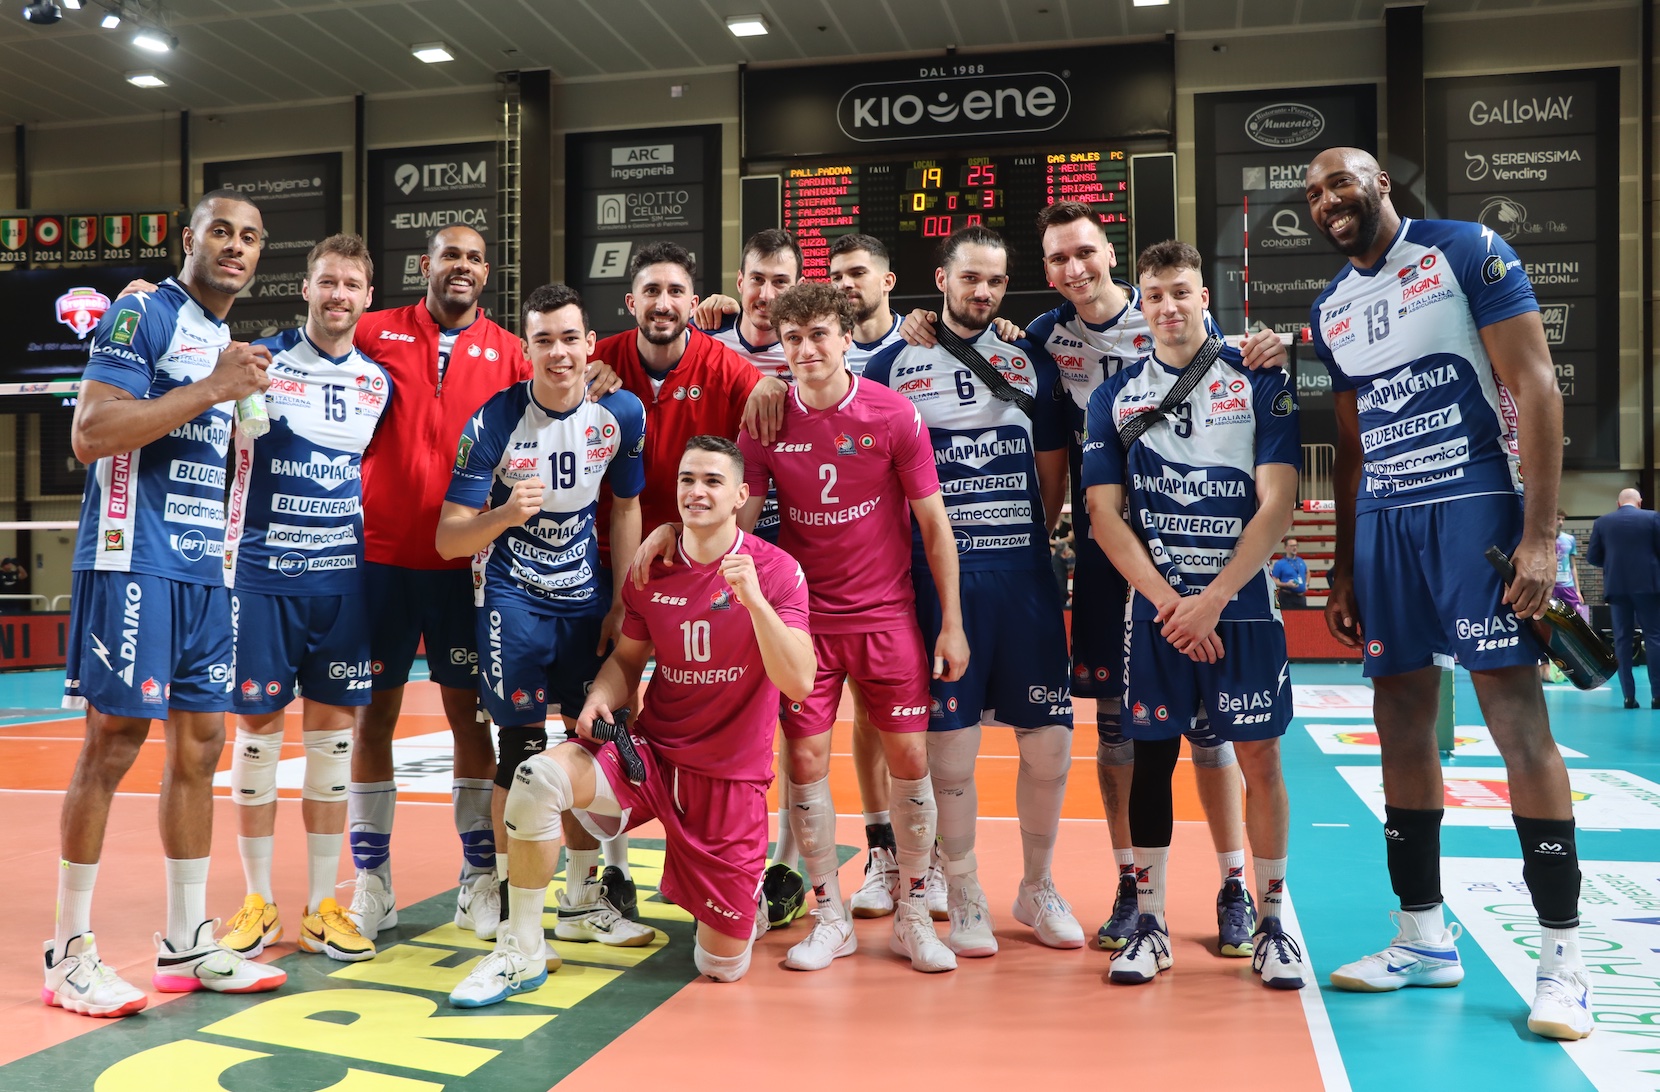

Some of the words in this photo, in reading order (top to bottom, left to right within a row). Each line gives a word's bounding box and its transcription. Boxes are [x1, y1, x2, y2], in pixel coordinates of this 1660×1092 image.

[920, 67, 947, 78] DAL
[953, 64, 985, 75] 1988
[1259, 119, 1311, 131] Munerato
[627, 148, 660, 162] ARC
[967, 157, 990, 166] OSPITI
[1047, 154, 1066, 164] GAS
[1070, 152, 1101, 163] SALES
[1110, 151, 1124, 160] PC
[913, 160, 936, 169] LOCALI
[1047, 165, 1054, 174] 3
[423, 161, 487, 187] IT&M
[611, 164, 674, 180] ingegneria
[922, 168, 941, 189] 19
[967, 165, 995, 186] 25
[1492, 167, 1547, 181] Vending
[258, 178, 310, 193] Hygiene
[1047, 185, 1054, 194] 6
[1119, 182, 1126, 190] K
[1270, 179, 1307, 189] PERFORM
[626, 190, 689, 207] GIOTTO
[983, 190, 994, 208] 3
[633, 204, 682, 217] CELLINO
[852, 206, 860, 215] K
[394, 208, 487, 229] EUMEDICA
[1261, 238, 1312, 248] CONQUEST
[0, 252, 27, 262] 2013
[35, 251, 62, 261] 2014
[69, 250, 97, 260] 2015
[104, 249, 131, 259] 2015
[139, 248, 168, 258] 2016
[259, 283, 303, 297] ARCEL
[1402, 273, 1442, 300] PAGANI
[1407, 289, 1453, 309] ITALIANA
[1363, 299, 1390, 345] 13
[379, 330, 416, 343] Zeus
[1052, 335, 1083, 349] Zeus
[896, 363, 933, 378] Zeus
[954, 370, 974, 400] 6
[321, 383, 348, 423] 15
[1211, 398, 1247, 412] PAGANI
[1364, 408, 1452, 450] BLUENERGY
[774, 442, 813, 453] Zeus
[176, 464, 226, 486] BLUENE
[548, 451, 577, 490] 19
[818, 463, 840, 505] 2
[277, 497, 358, 514] BLUENERGY
[789, 496, 881, 527] BLUENERGY
[976, 536, 1028, 548] BURZONI
[312, 555, 355, 569] BURZONI
[650, 592, 688, 606] Zeus
[1456, 613, 1519, 640] GelAS
[679, 620, 711, 662] 10
[1476, 636, 1519, 652] Zeus
[661, 664, 749, 685] BLUENERGY
[1218, 691, 1273, 712] GelAS
[891, 704, 927, 717] Zeus
[1232, 712, 1272, 725] Zeus
